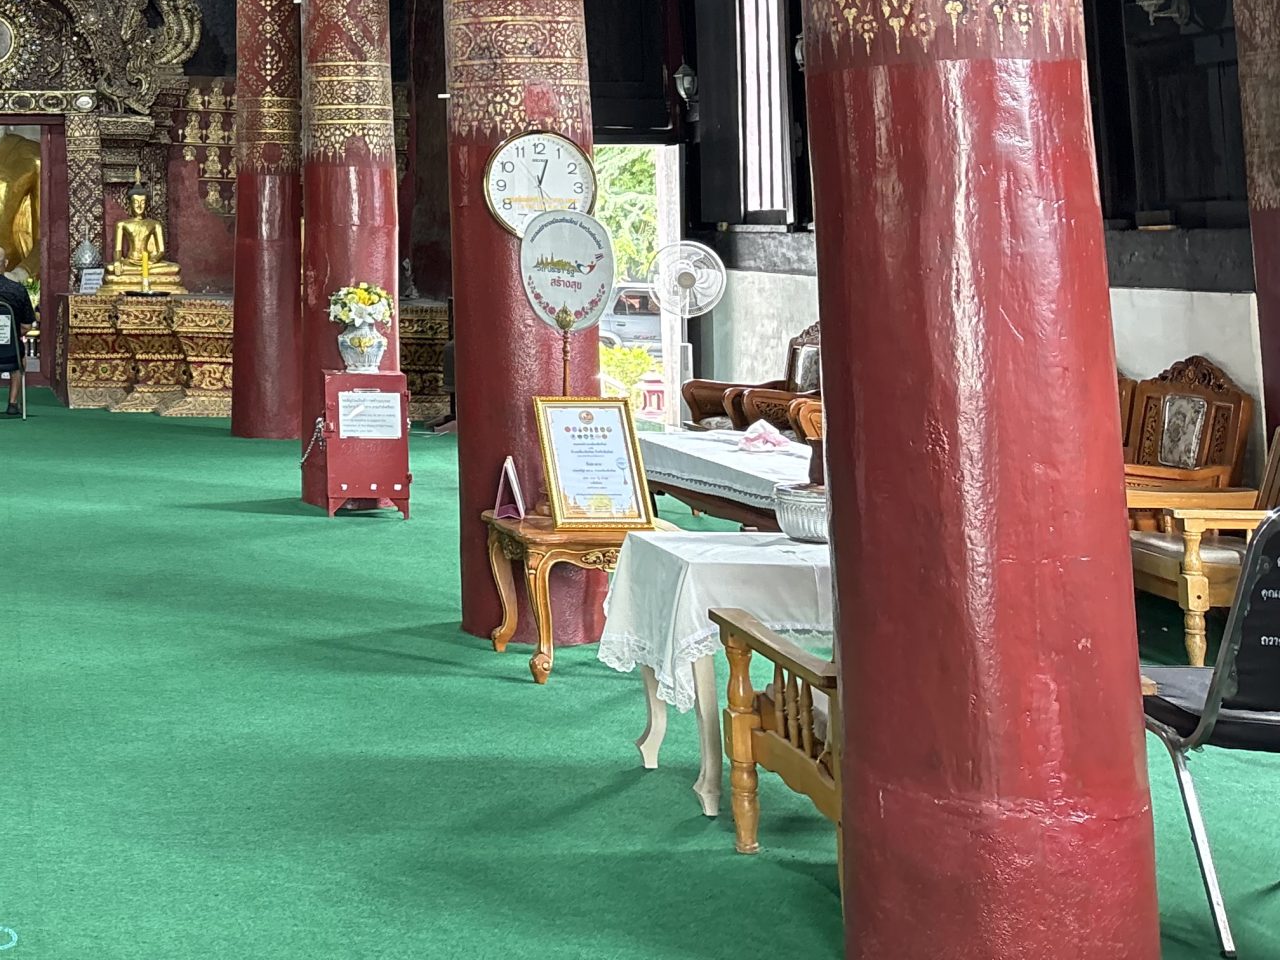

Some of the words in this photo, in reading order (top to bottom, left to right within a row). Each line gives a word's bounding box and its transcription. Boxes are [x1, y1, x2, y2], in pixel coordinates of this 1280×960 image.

[515, 145, 525, 158] 11
[532, 142, 546, 155] 12
[556, 147, 561, 160] 1
[500, 160, 515, 173] 10
[567, 162, 577, 175] 2
[496, 179, 507, 192] 9
[573, 181, 584, 194] 3
[502, 197, 512, 210] 8
[567, 198, 578, 210] 4
[550, 276, 582, 292] สร้างสุข
[1261, 636, 1280, 646] ถวา
